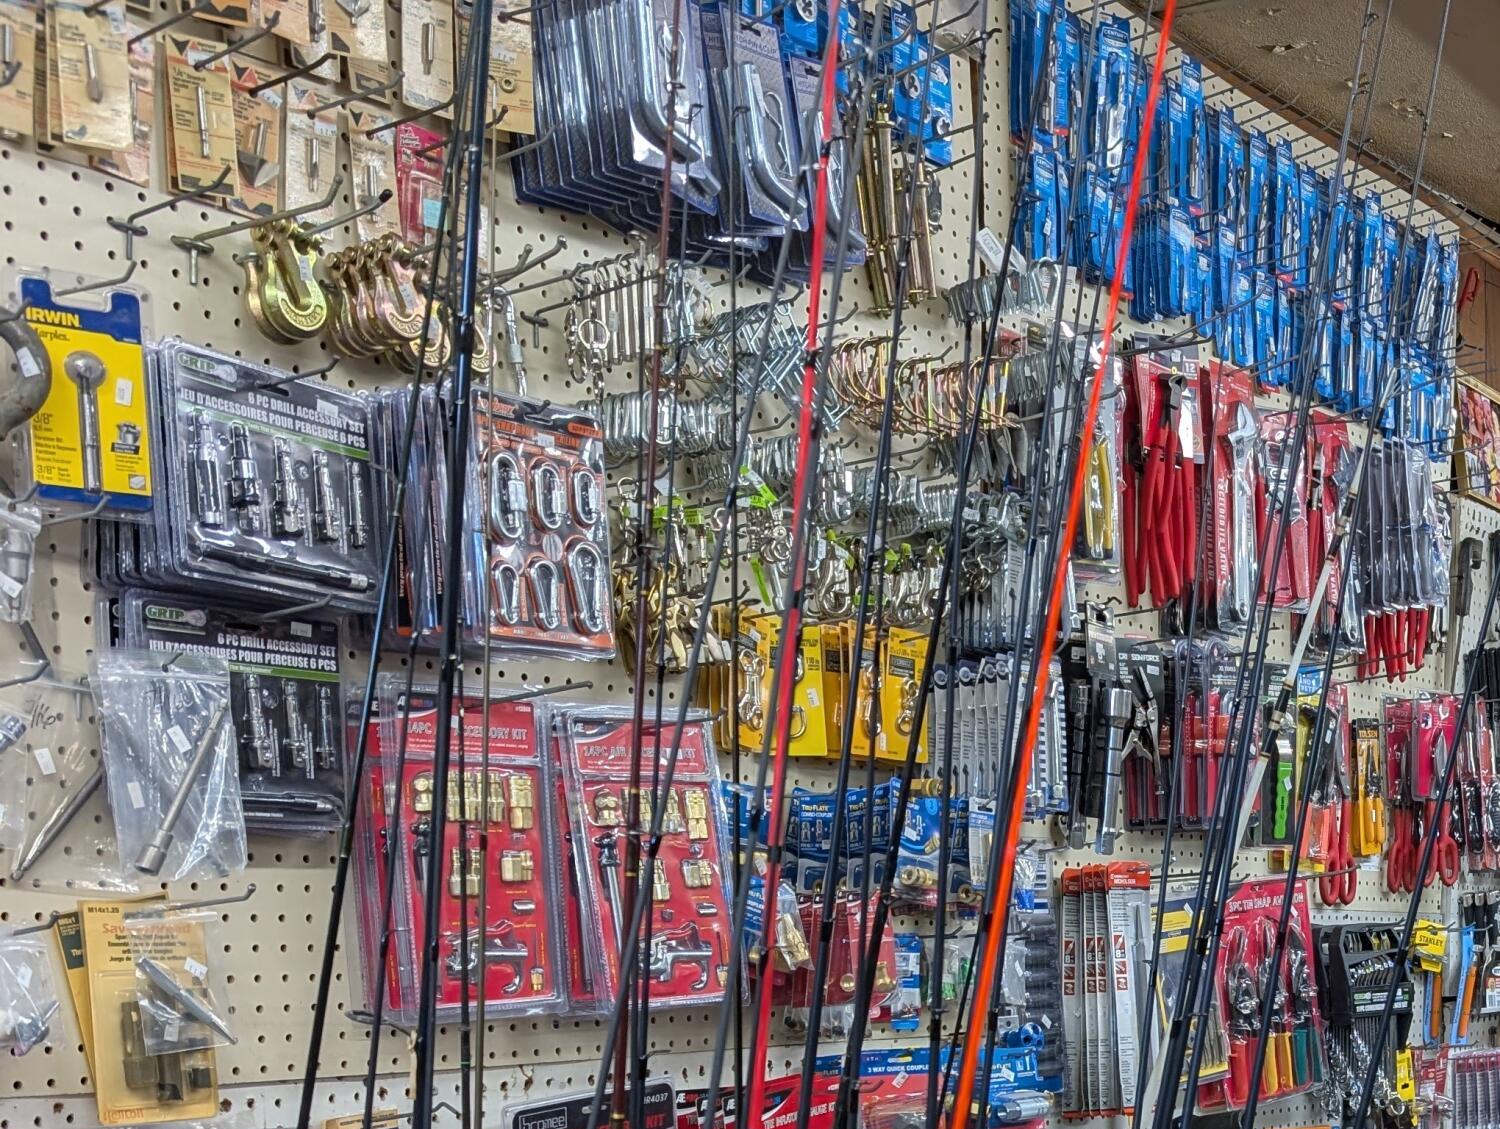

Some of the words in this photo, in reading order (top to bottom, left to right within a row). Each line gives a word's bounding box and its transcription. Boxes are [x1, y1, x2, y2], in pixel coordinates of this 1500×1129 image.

[25, 307, 81, 327] IRWIN
[180, 387, 198, 404] JEU
[198, 392, 268, 423] D'ACCESSOIRES
[269, 411, 293, 430] POUR
[294, 418, 339, 442] PERCEUSE
[339, 429, 346, 443] 6
[347, 431, 366, 449] PCS
[249, 393, 256, 405] 6
[257, 394, 269, 407] PC
[270, 397, 295, 416] DRILL
[296, 403, 349, 432] ACCESSORY
[349, 418, 365, 435] SET
[149, 607, 185, 620] GRIP
[217, 632, 225, 645] 6
[226, 633, 239, 646] PC
[239, 635, 266, 650] DRILL
[266, 638, 319, 657] ACCESSORY
[319, 645, 336, 658] SET
[238, 649, 263, 664] POUR
[264, 651, 309, 670] PERCEUSE
[309, 657, 316, 670] 6
[317, 659, 337, 671] PCS
[1419, 935, 1443, 947] STANLEY
[886, 1065, 905, 1073] QUICK
[645, 1114, 666, 1129] KIT
